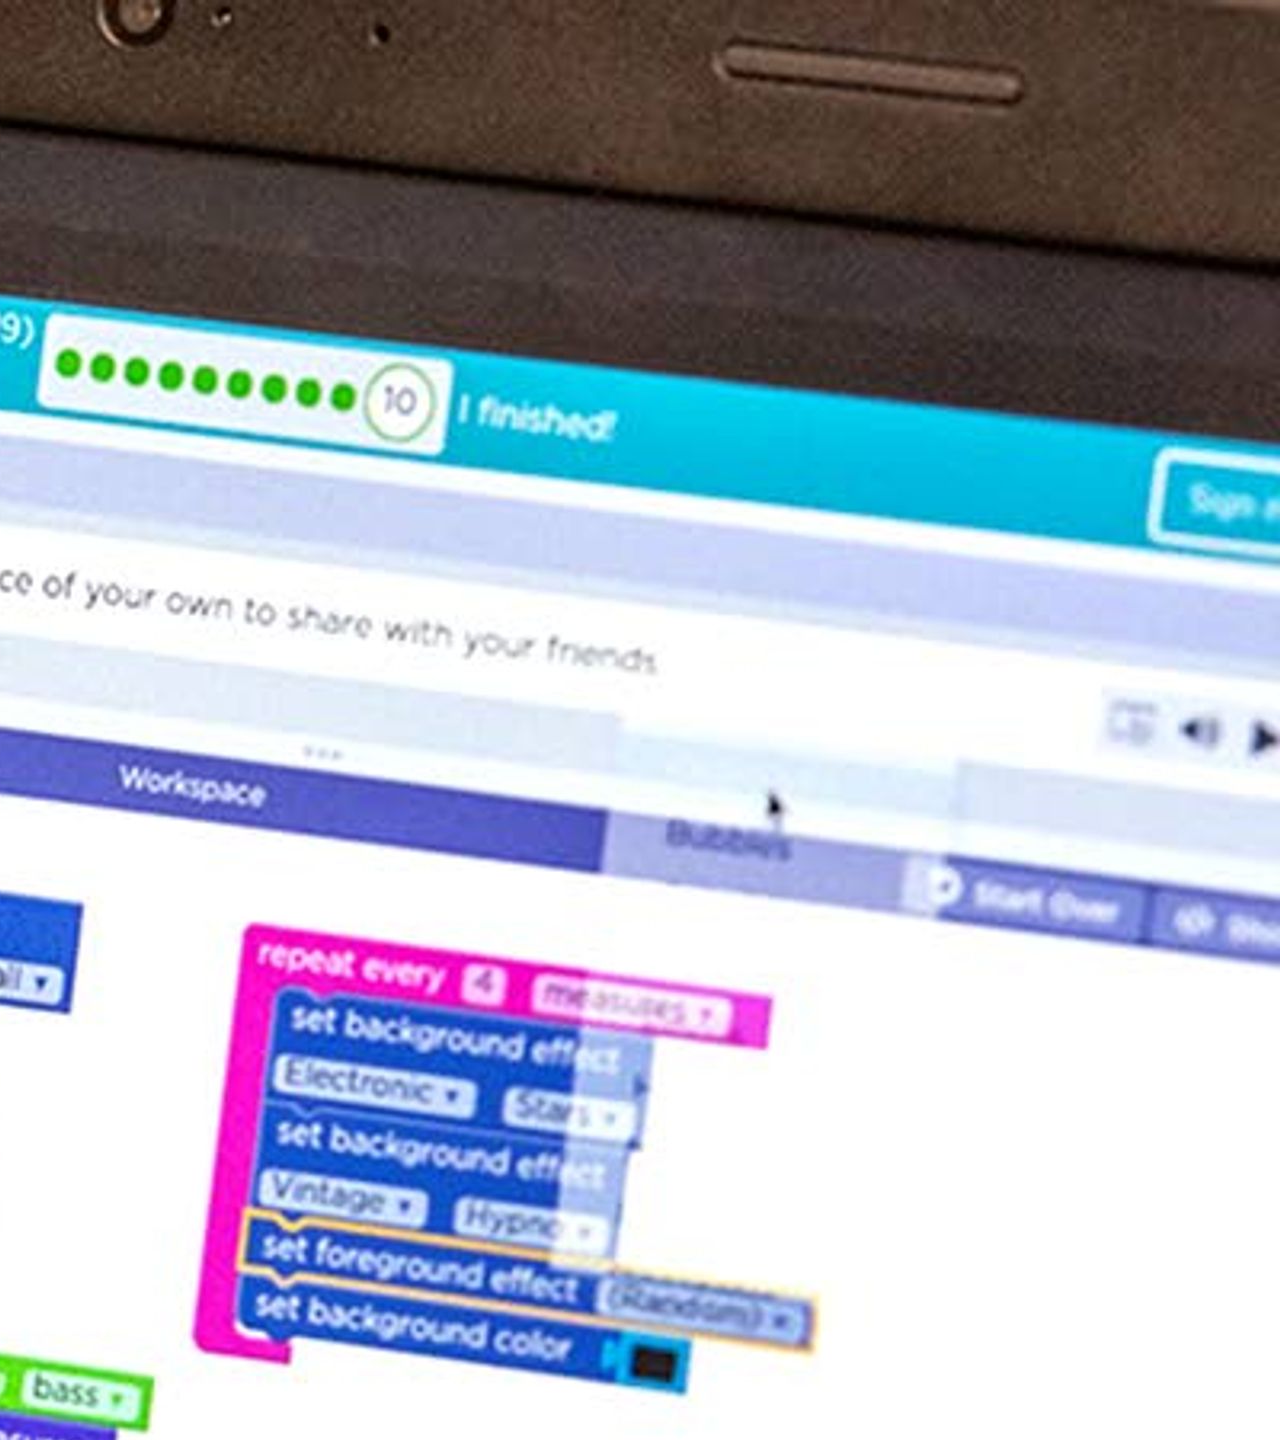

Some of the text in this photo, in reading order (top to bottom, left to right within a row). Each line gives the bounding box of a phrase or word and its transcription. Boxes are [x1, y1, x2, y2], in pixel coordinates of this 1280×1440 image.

[382, 385, 418, 418] 10
[457, 395, 617, 444] I finished!
[41, 571, 76, 600] of
[85, 584, 157, 614] your
[166, 590, 233, 619] own
[245, 599, 276, 629] to
[288, 602, 373, 640] share
[383, 614, 452, 650] with
[463, 628, 538, 662] your
[120, 763, 267, 808] Workspace
[258, 942, 686, 1025] repeat every 4 measures
[291, 1003, 621, 1072] set background effect
[285, 1059, 590, 1127] Electronic Stars
[276, 1118, 607, 1188] set background effect
[273, 1173, 564, 1243] Vintage Hypno
[263, 1233, 309, 1264] set
[315, 1233, 484, 1292] foreground
[490, 1263, 581, 1304] effect
[254, 1289, 574, 1363] set background color
[32, 1371, 101, 1407] bass
